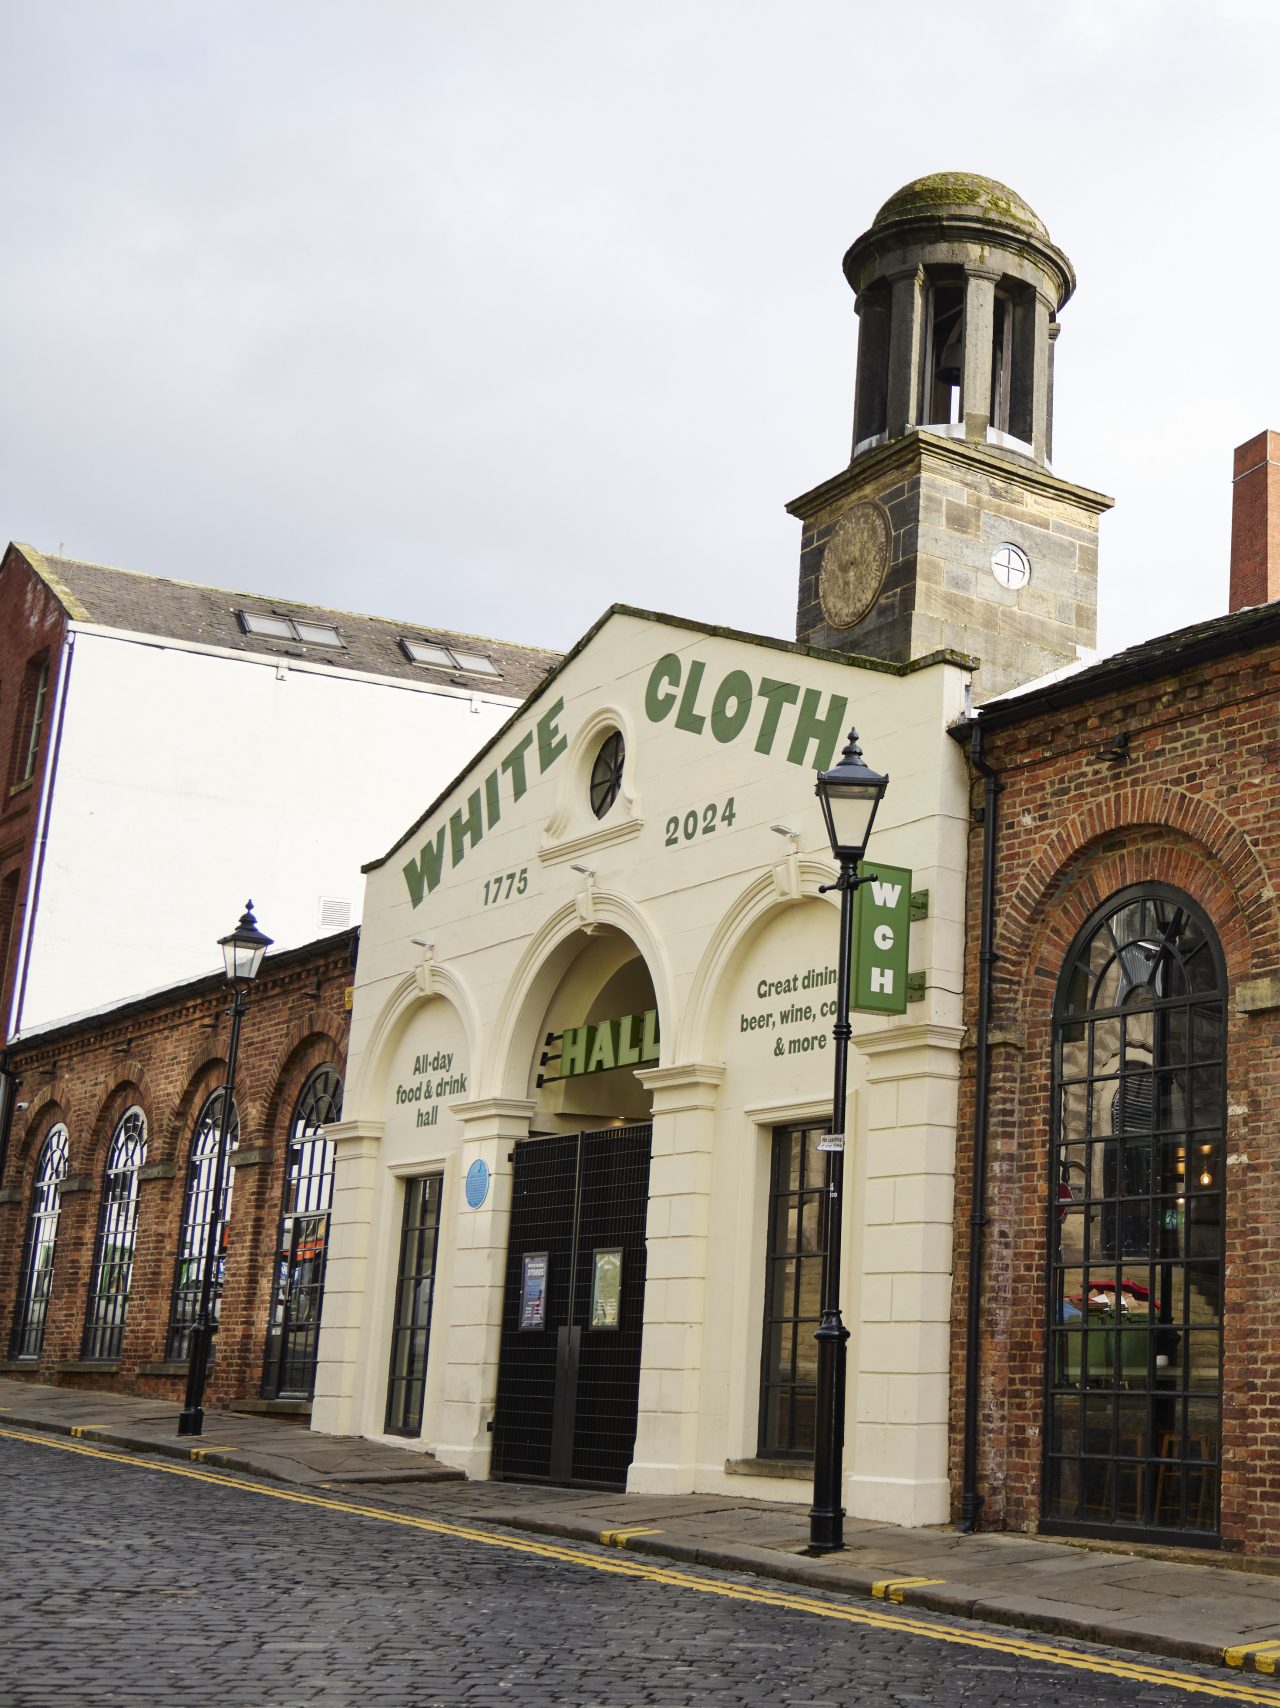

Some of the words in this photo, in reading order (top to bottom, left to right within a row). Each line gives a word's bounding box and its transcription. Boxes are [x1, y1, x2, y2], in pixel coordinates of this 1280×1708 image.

[402, 696, 568, 910] WHITE
[644, 652, 849, 773] CLOTH
[664, 796, 738, 847] 2024
[482, 866, 529, 907] 1775
[870, 880, 903, 995] WCH
[757, 974, 799, 998] Great
[801, 966, 839, 990] dinin
[740, 1012, 776, 1032] beer,
[780, 1004, 816, 1024] wine,
[560, 1009, 660, 1077] HALL
[774, 1037, 785, 1057] &
[788, 1034, 827, 1054] more
[396, 1081, 423, 1105] food
[424, 1080, 433, 1099] &
[436, 1073, 468, 1098] drink
[416, 1105, 439, 1128] hall
